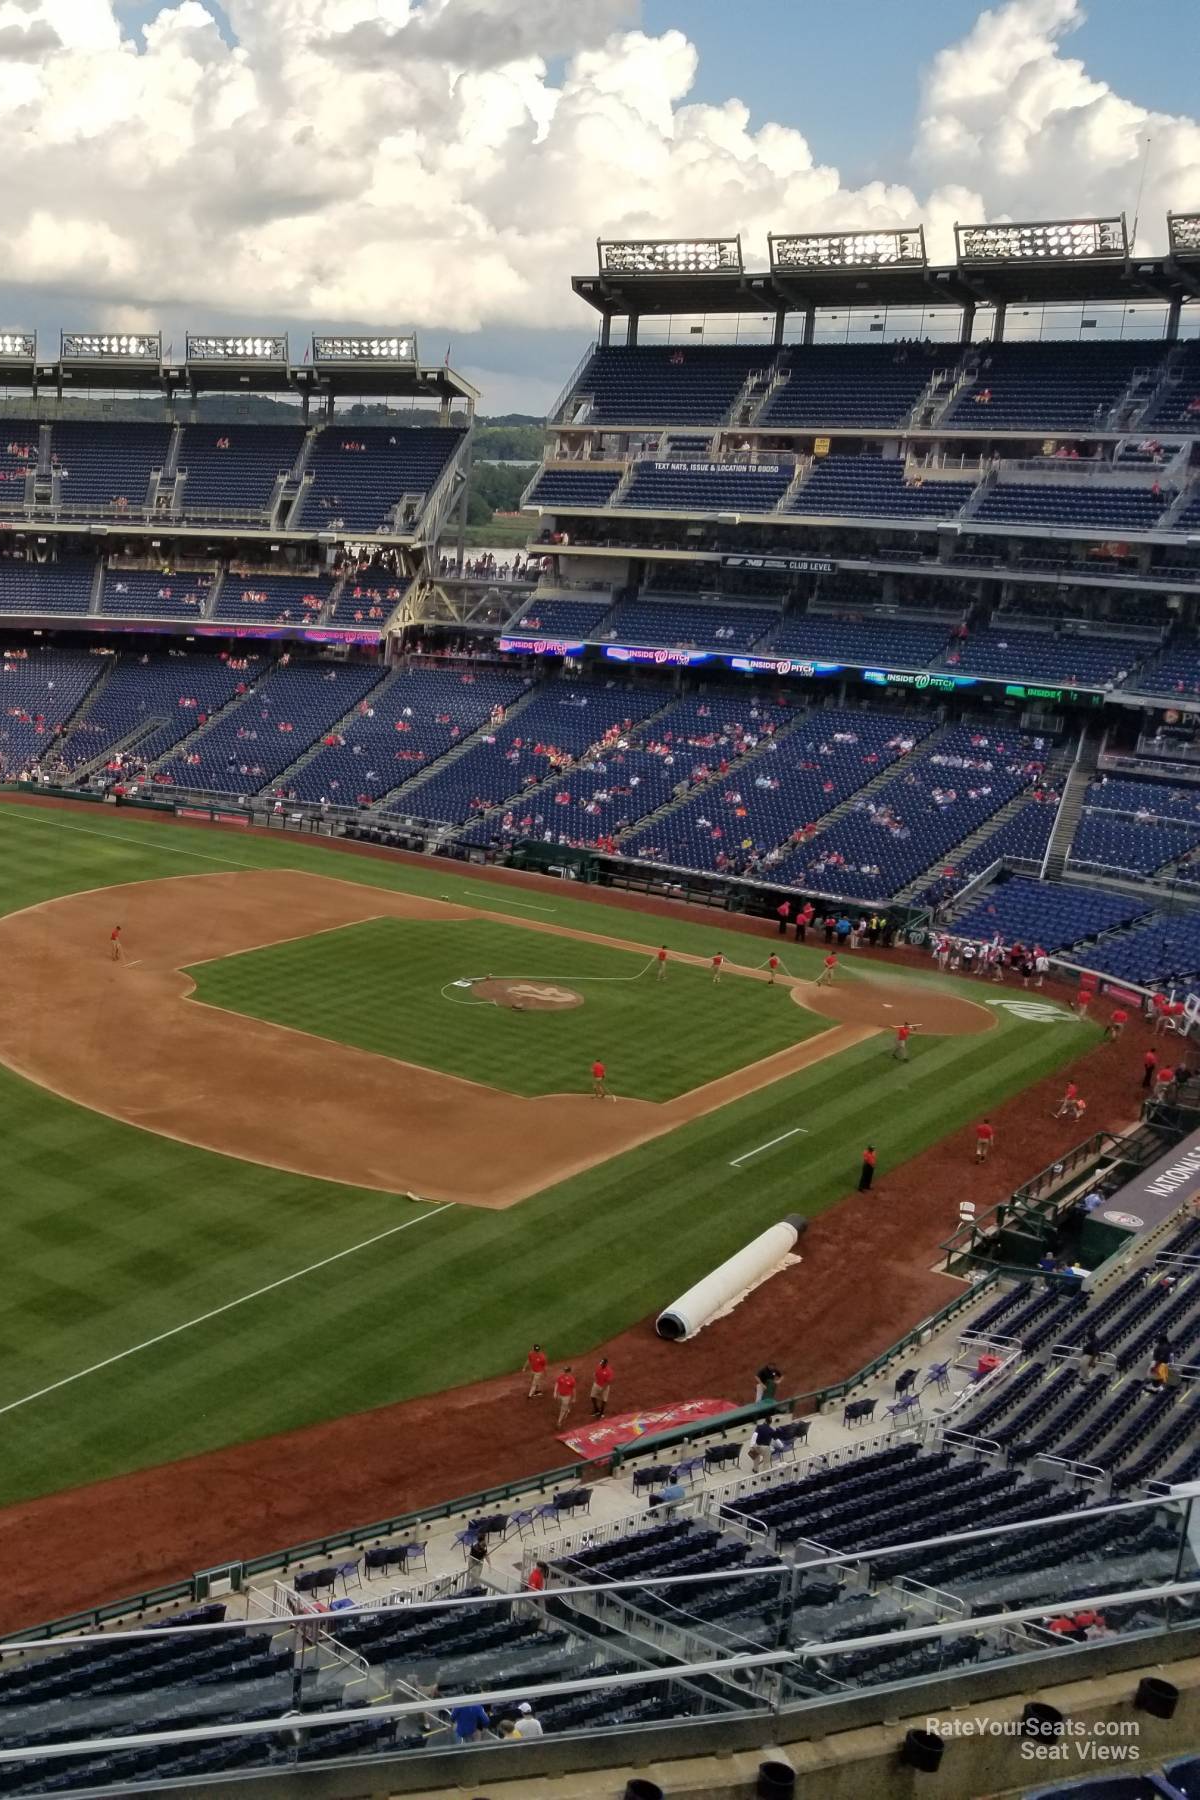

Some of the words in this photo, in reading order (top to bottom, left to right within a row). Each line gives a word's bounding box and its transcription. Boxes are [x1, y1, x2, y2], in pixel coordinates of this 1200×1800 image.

[655, 462, 670, 470] TEXT
[789, 561, 808, 570] CLUB
[809, 562, 832, 572] LEVEL
[629, 650, 654, 658] INSIDE
[668, 653, 689, 661] PITCH
[750, 661, 776, 669] INSIDE
[791, 664, 814, 672] PITCH
[887, 674, 914, 683] INSIDE
[930, 678, 955, 688] PITCH
